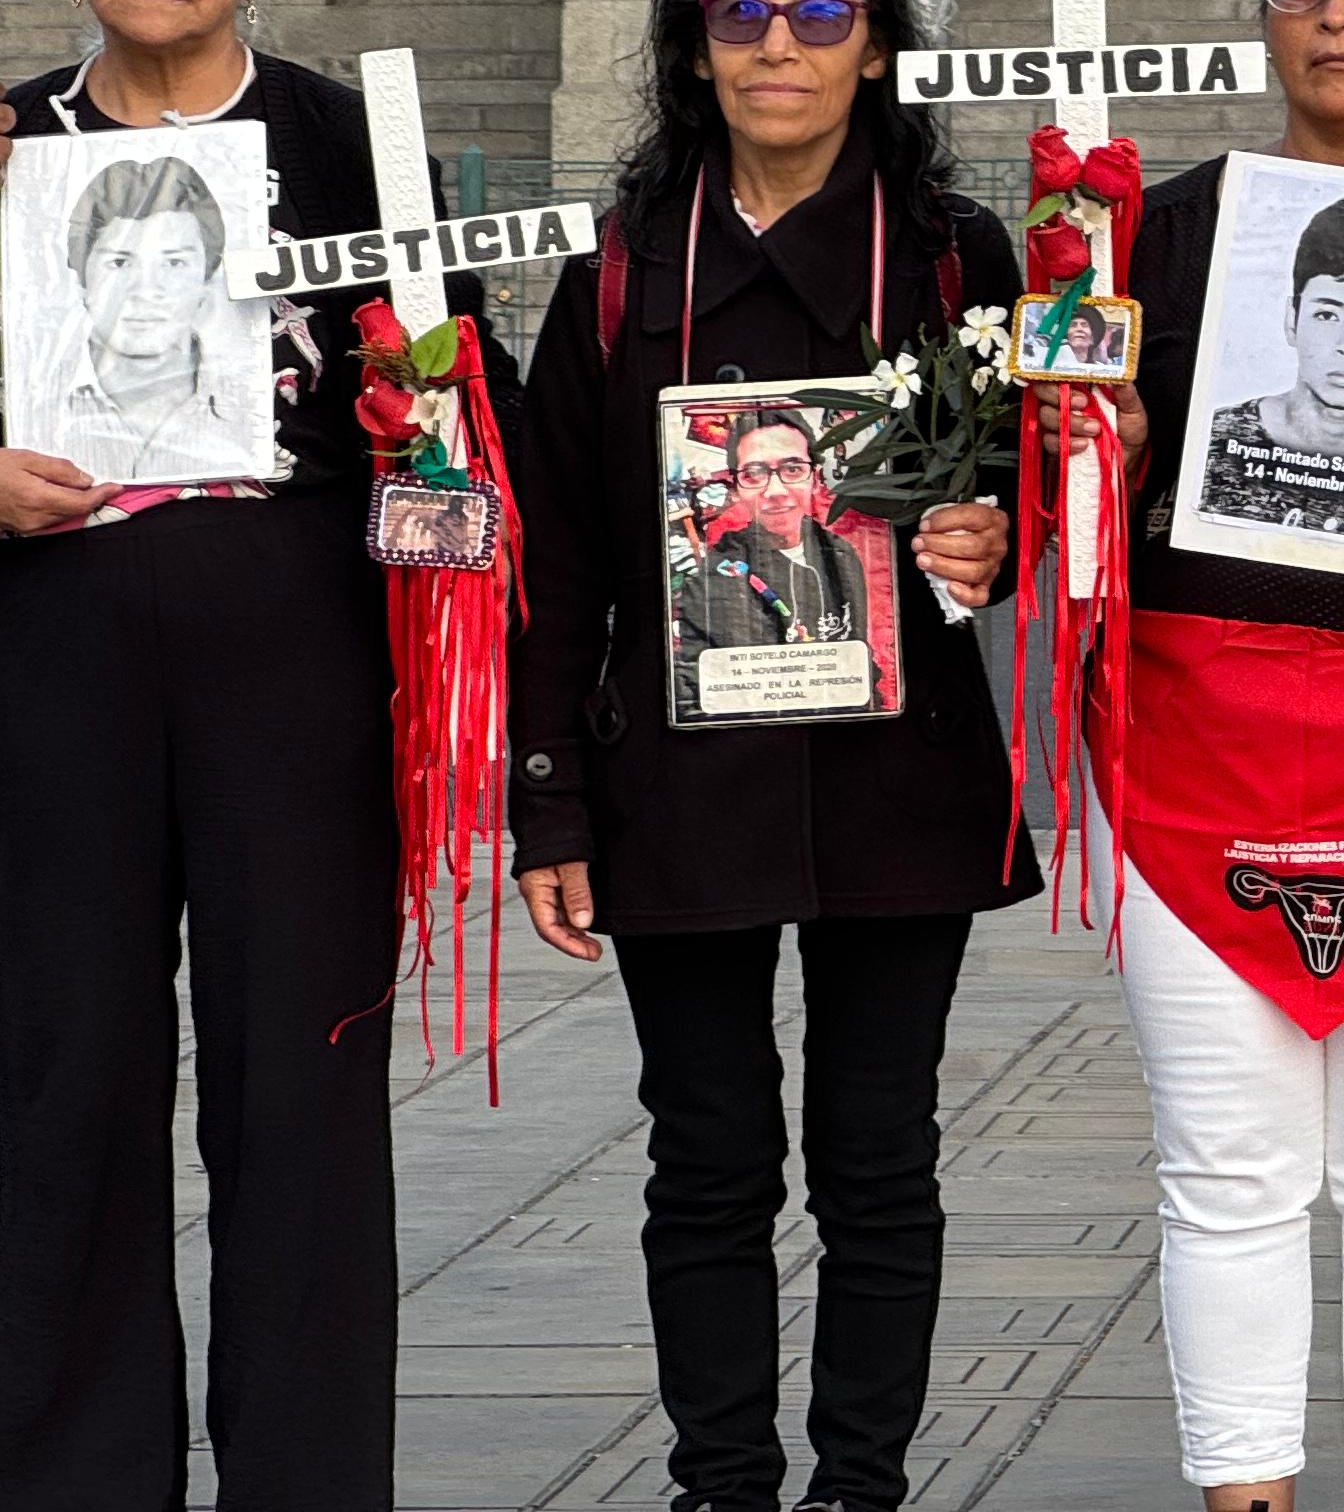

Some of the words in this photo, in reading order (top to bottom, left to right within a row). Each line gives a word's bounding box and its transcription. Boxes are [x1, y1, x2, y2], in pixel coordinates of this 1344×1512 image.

[914, 46, 1239, 100] JUSTICIA
[254, 210, 572, 292] JUSTICIA
[1226, 439, 1271, 462] Bryan
[1272, 446, 1330, 470] Pintado
[1244, 462, 1265, 479] 14
[768, 681, 782, 689] EN
[788, 679, 802, 687] LA
[1279, 853, 1288, 864] Y
